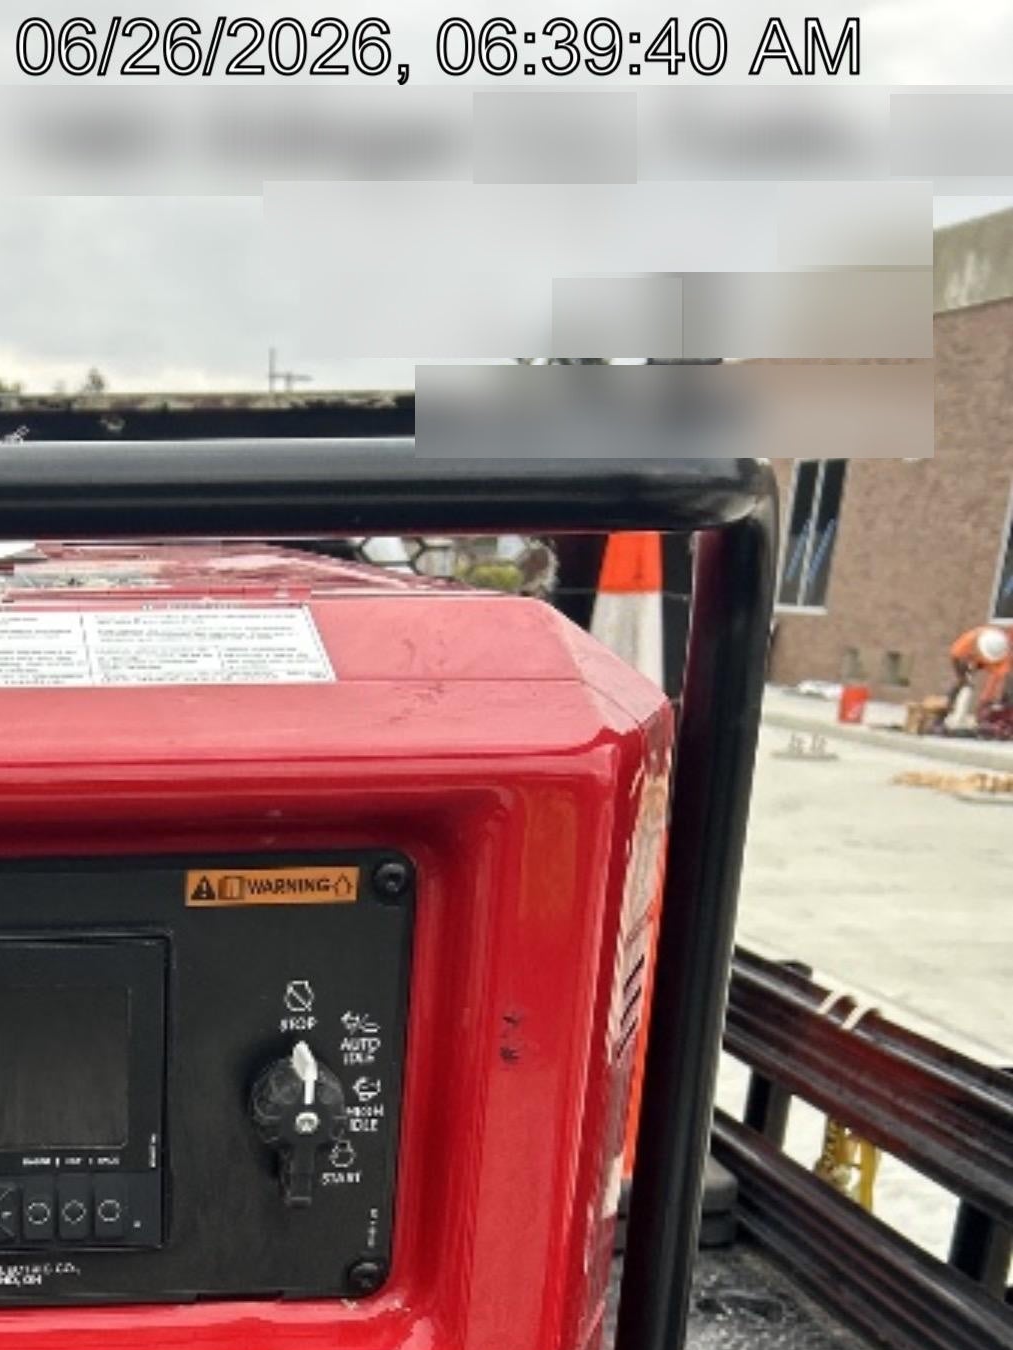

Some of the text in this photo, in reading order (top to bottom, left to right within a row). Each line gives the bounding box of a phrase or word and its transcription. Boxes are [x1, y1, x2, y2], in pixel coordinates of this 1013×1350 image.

[246, 877, 332, 895] WARNING
[279, 1015, 318, 1032] STOP
[339, 1037, 381, 1052] AUTO
[349, 1118, 379, 1132] IDLE
